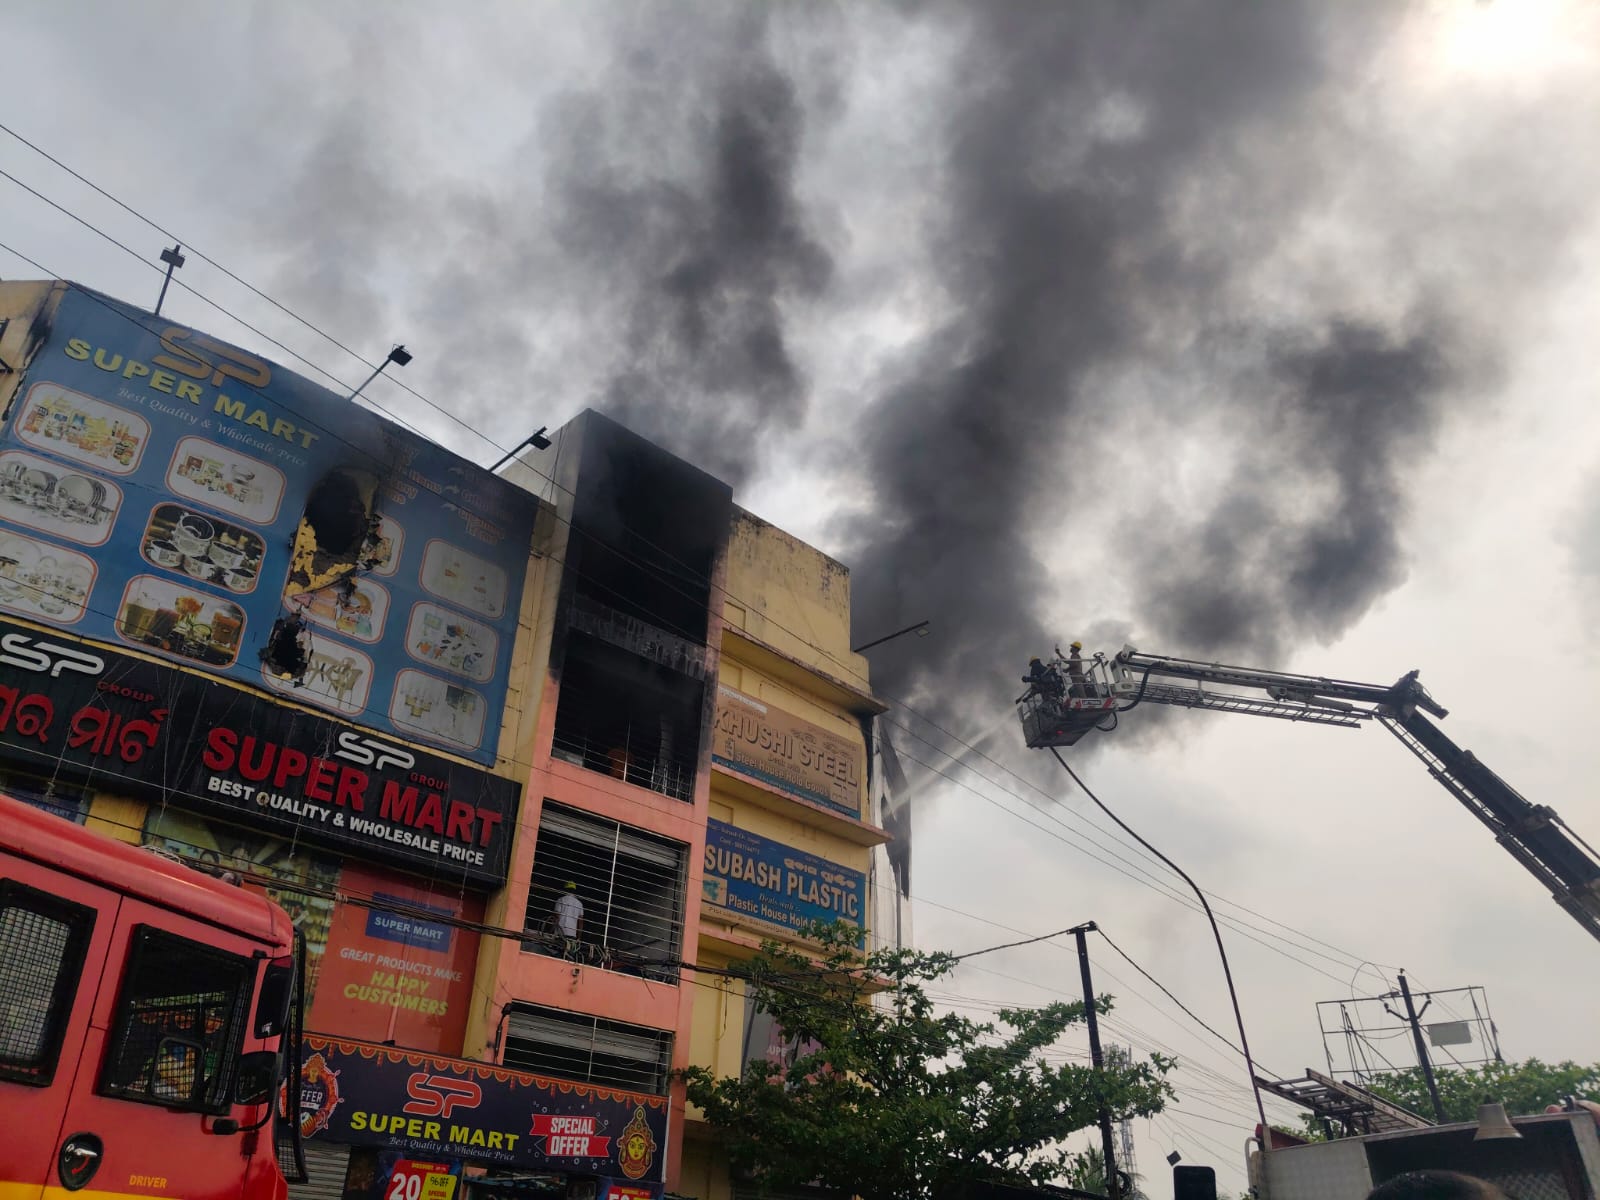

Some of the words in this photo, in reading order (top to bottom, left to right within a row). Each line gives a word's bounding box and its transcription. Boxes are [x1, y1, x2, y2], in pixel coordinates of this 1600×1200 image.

[152, 326, 272, 388] SP
[64, 337, 206, 405] SUPER
[213, 394, 320, 449] MART
[118, 386, 146, 405] Best
[149, 398, 197, 425] Quality
[201, 418, 212, 429] &
[218, 422, 273, 455] Wholesale
[0, 633, 105, 678] SP
[97, 680, 154, 702] GROUP
[333, 730, 416, 771] SP
[714, 704, 794, 760] KHUSHI
[799, 742, 858, 789] STEEL
[202, 727, 369, 813] SUPER
[379, 779, 503, 848] MART
[207, 776, 255, 801] BEST
[255, 791, 332, 823] QUALITY
[332, 812, 345, 828] &
[349, 816, 440, 855] WHOLESALE
[441, 842, 485, 867] PRICE
[704, 843, 782, 893] SUBASH
[786, 872, 859, 918] PLASTIC
[728, 894, 758, 913] Plastic
[761, 903, 787, 923] House
[374, 916, 411, 932] SUPER
[412, 925, 444, 940] MART
[340, 947, 374, 963] GREAT
[376, 954, 433, 977] PRODUCTS
[433, 967, 465, 982] MAKE
[343, 983, 448, 1016] CUSTOMERS
[370, 970, 430, 995] HAPPY
[300, 1089, 323, 1103] FFER
[402, 1072, 483, 1118] SP
[350, 1110, 441, 1141] SUPER
[449, 1124, 520, 1152] MART
[550, 1116, 594, 1135] SPECIAL
[388, 1136, 407, 1148] Best
[409, 1139, 442, 1153] Quality
[443, 1144, 451, 1152] &
[454, 1143, 493, 1160] Wholesale
[494, 1150, 516, 1162] Price
[550, 1135, 590, 1156] OFFER
[129, 1175, 168, 1189] DRIVER
[389, 1172, 421, 1200] 20
